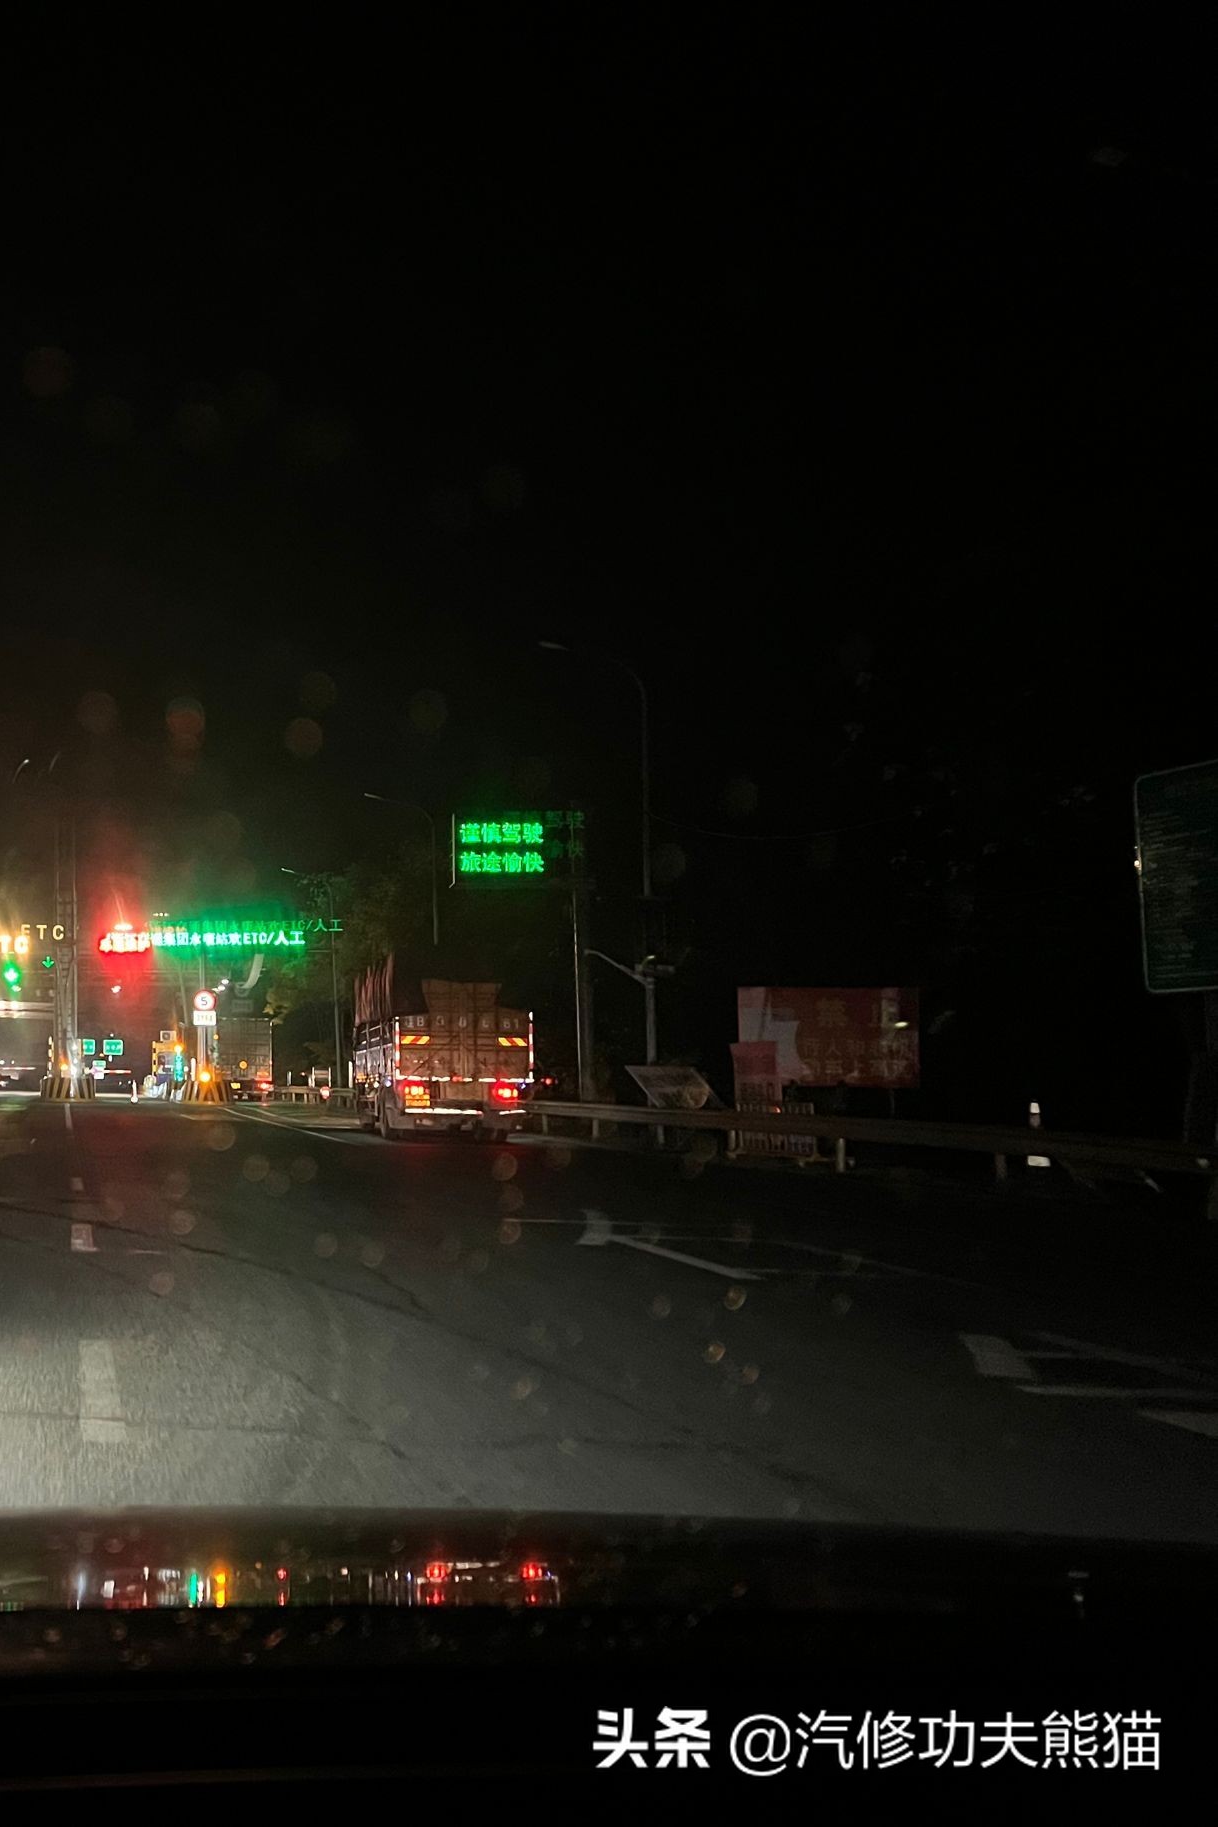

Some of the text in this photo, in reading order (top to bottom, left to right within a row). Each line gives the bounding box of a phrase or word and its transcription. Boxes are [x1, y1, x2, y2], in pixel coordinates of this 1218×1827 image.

[459, 822, 544, 843] 谨慎驾驶
[460, 851, 544, 872] 旅途愉快
